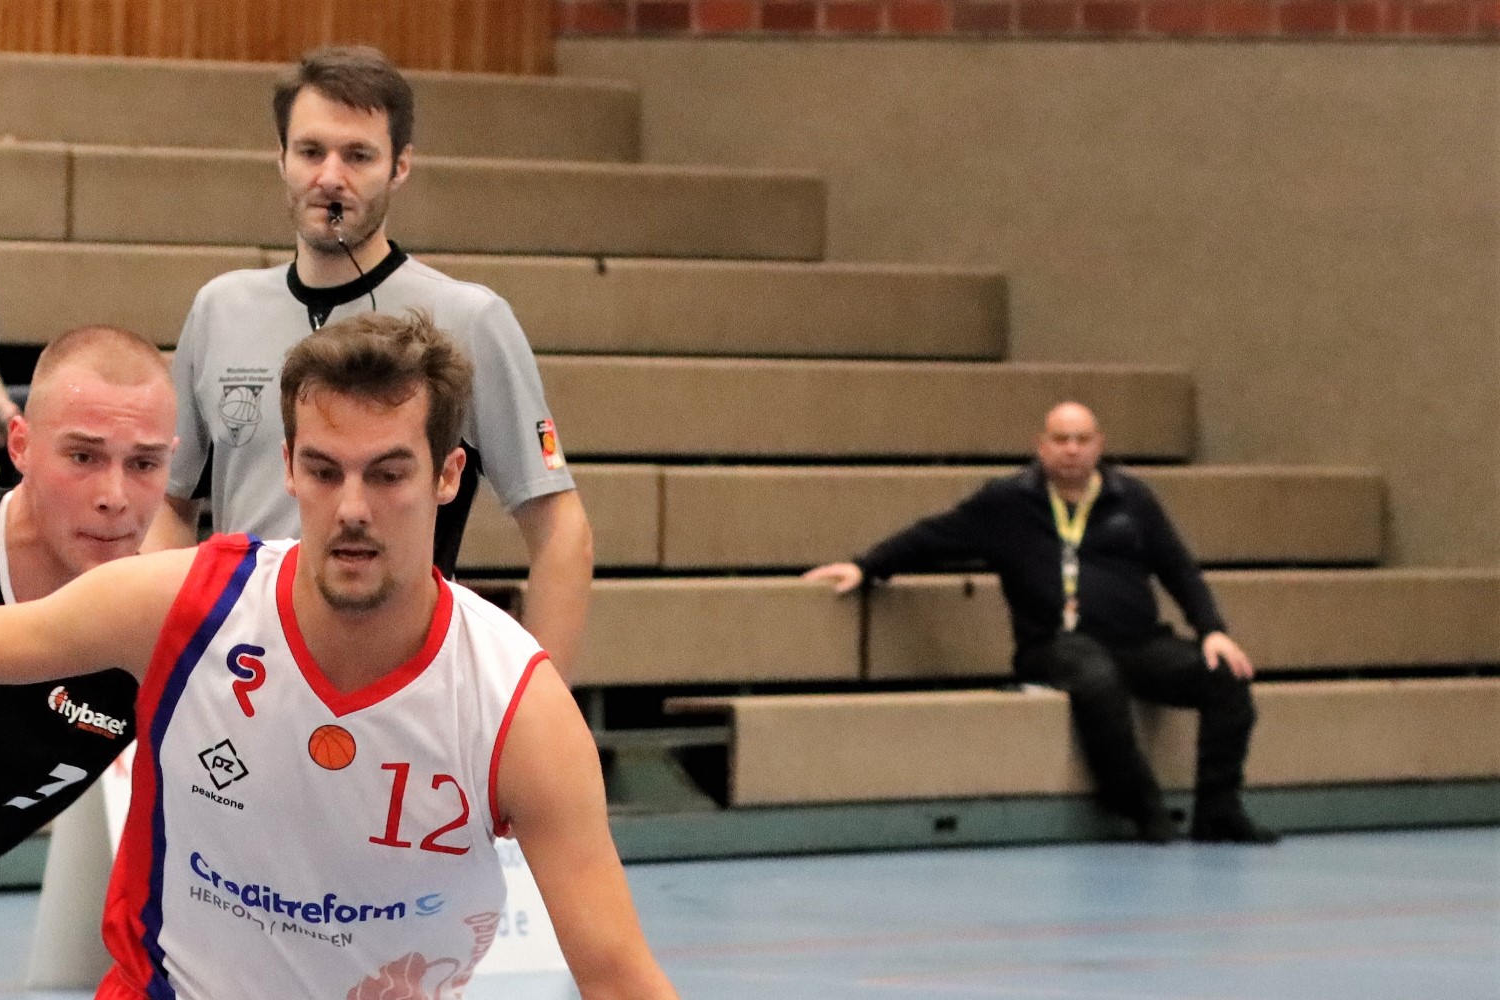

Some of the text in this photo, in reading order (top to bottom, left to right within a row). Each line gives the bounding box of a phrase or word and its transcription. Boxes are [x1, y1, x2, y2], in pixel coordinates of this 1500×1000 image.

[191, 784, 245, 811] peakzone
[369, 762, 472, 856] 12
[190, 851, 406, 924] Creditreform
